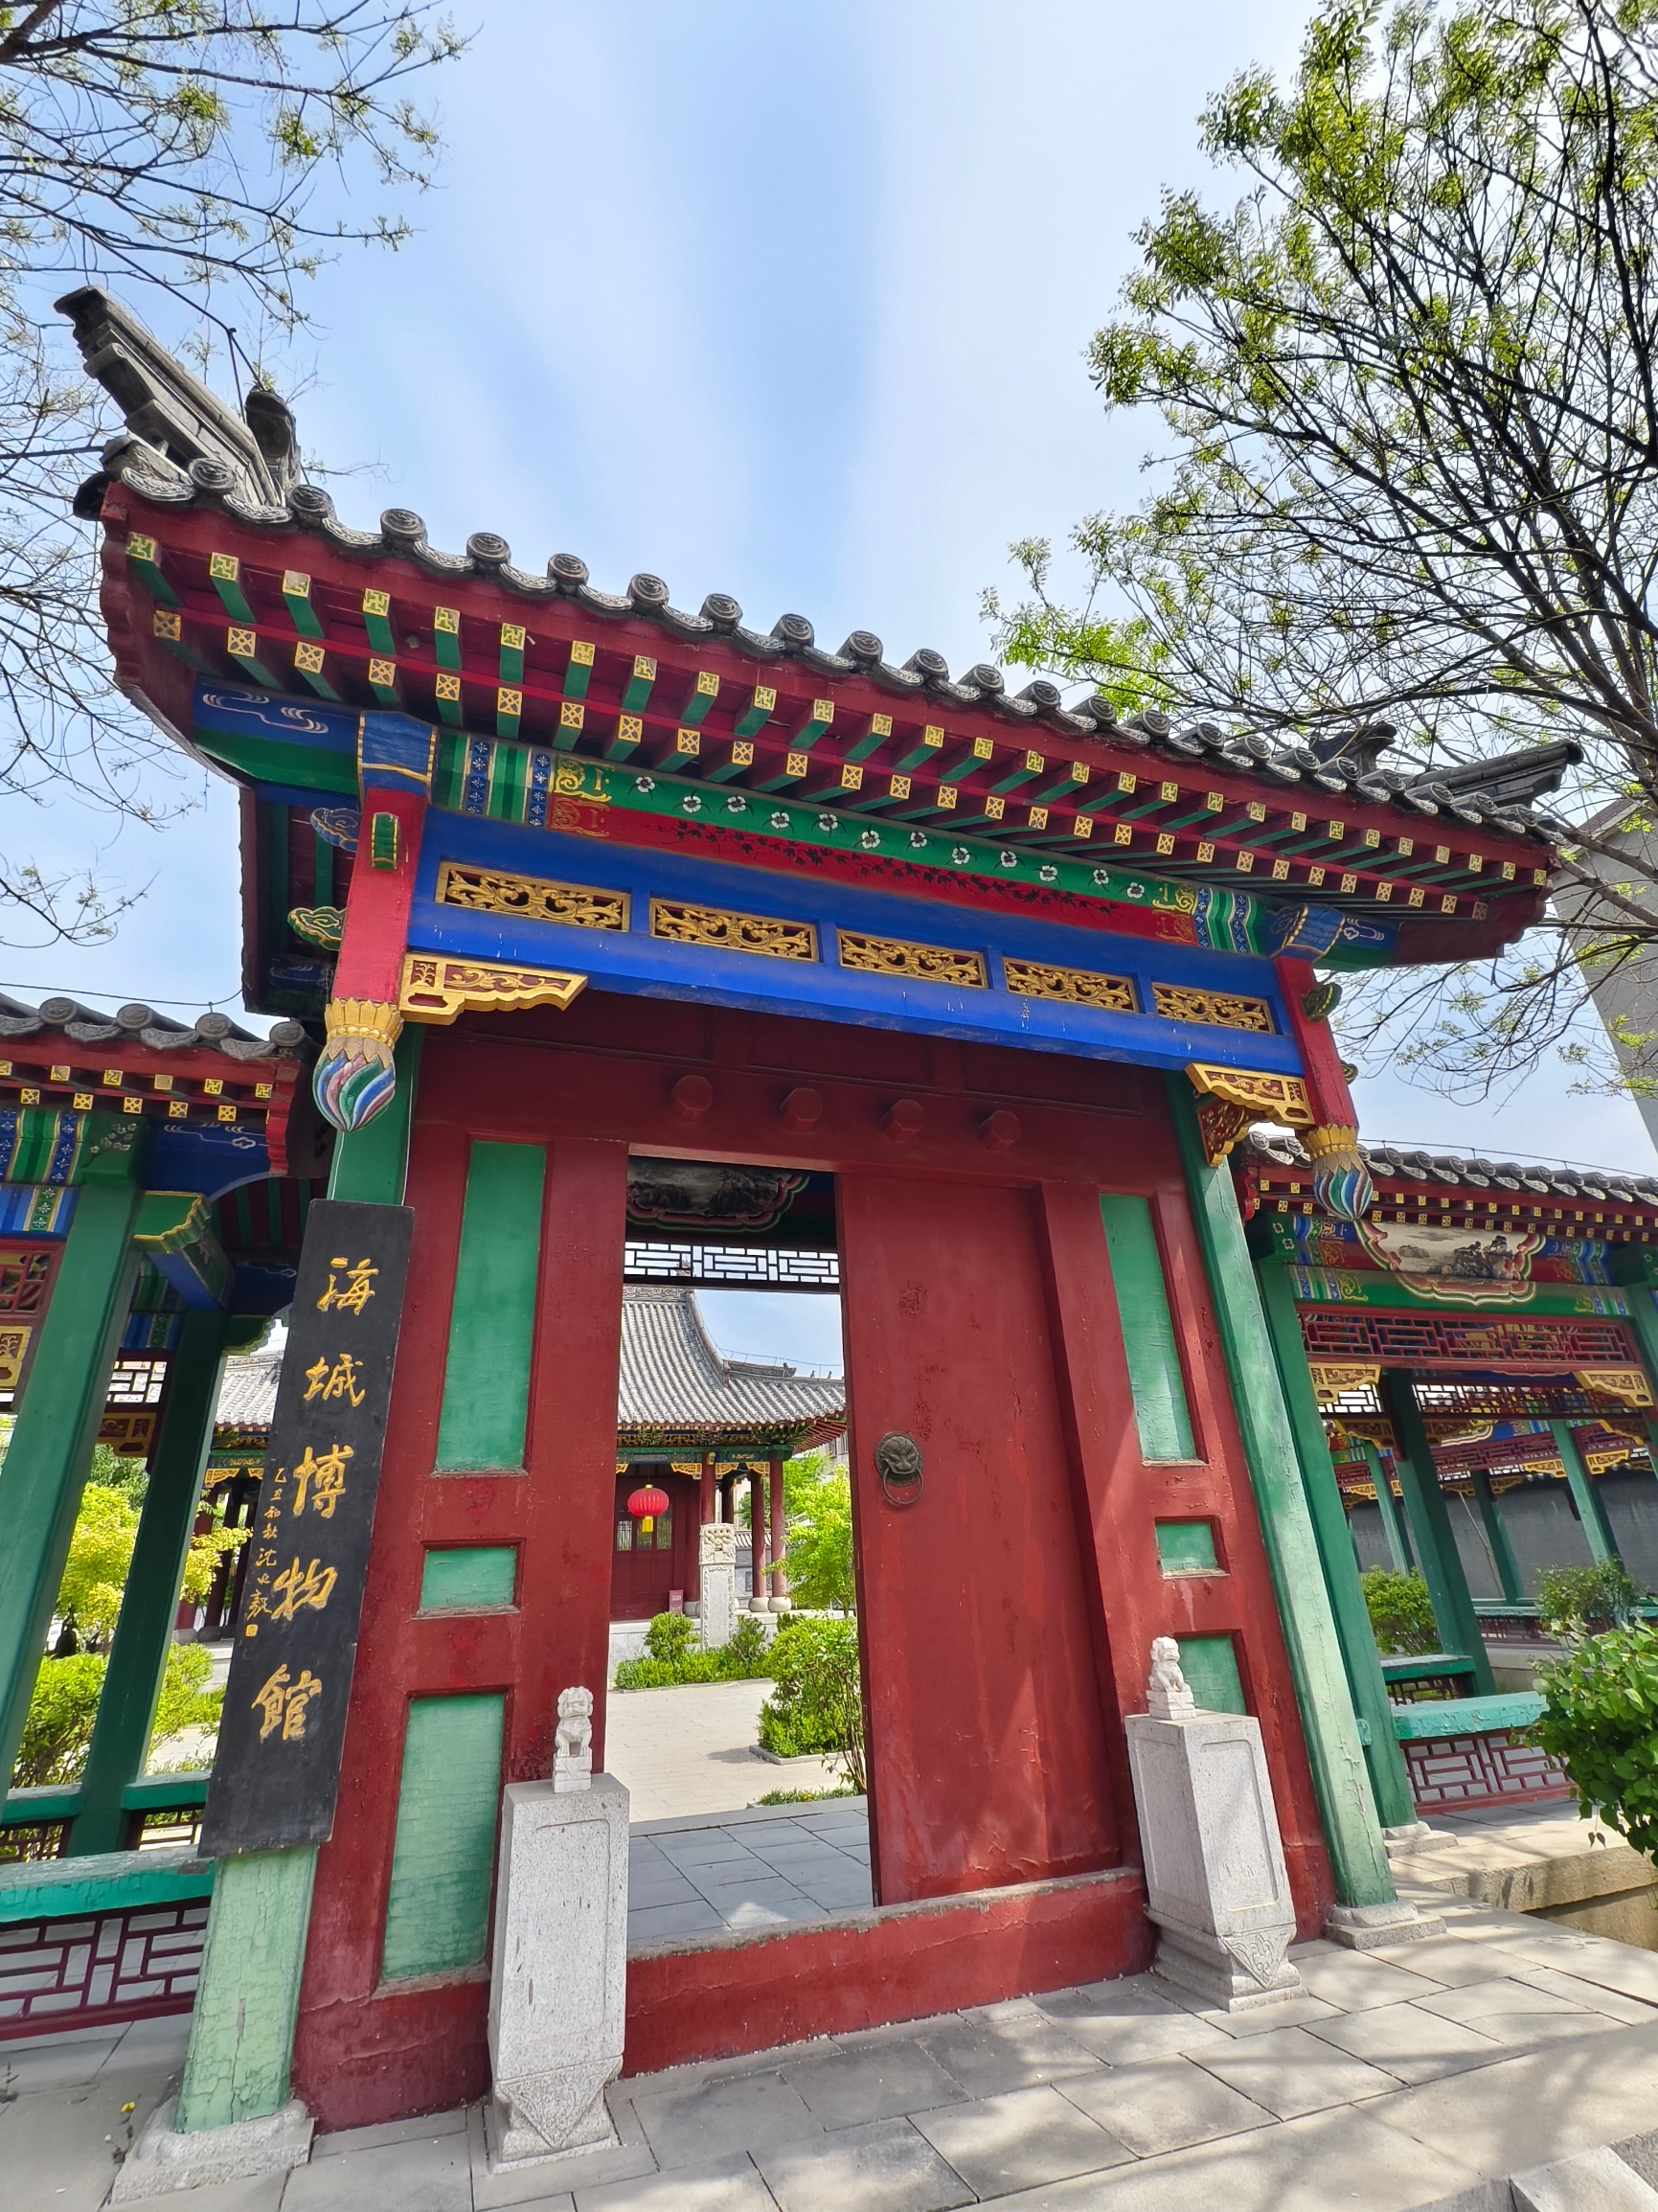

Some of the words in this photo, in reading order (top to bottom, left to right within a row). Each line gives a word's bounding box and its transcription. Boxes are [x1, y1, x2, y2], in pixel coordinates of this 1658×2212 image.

[250, 1256, 378, 1742] 海城博物館
